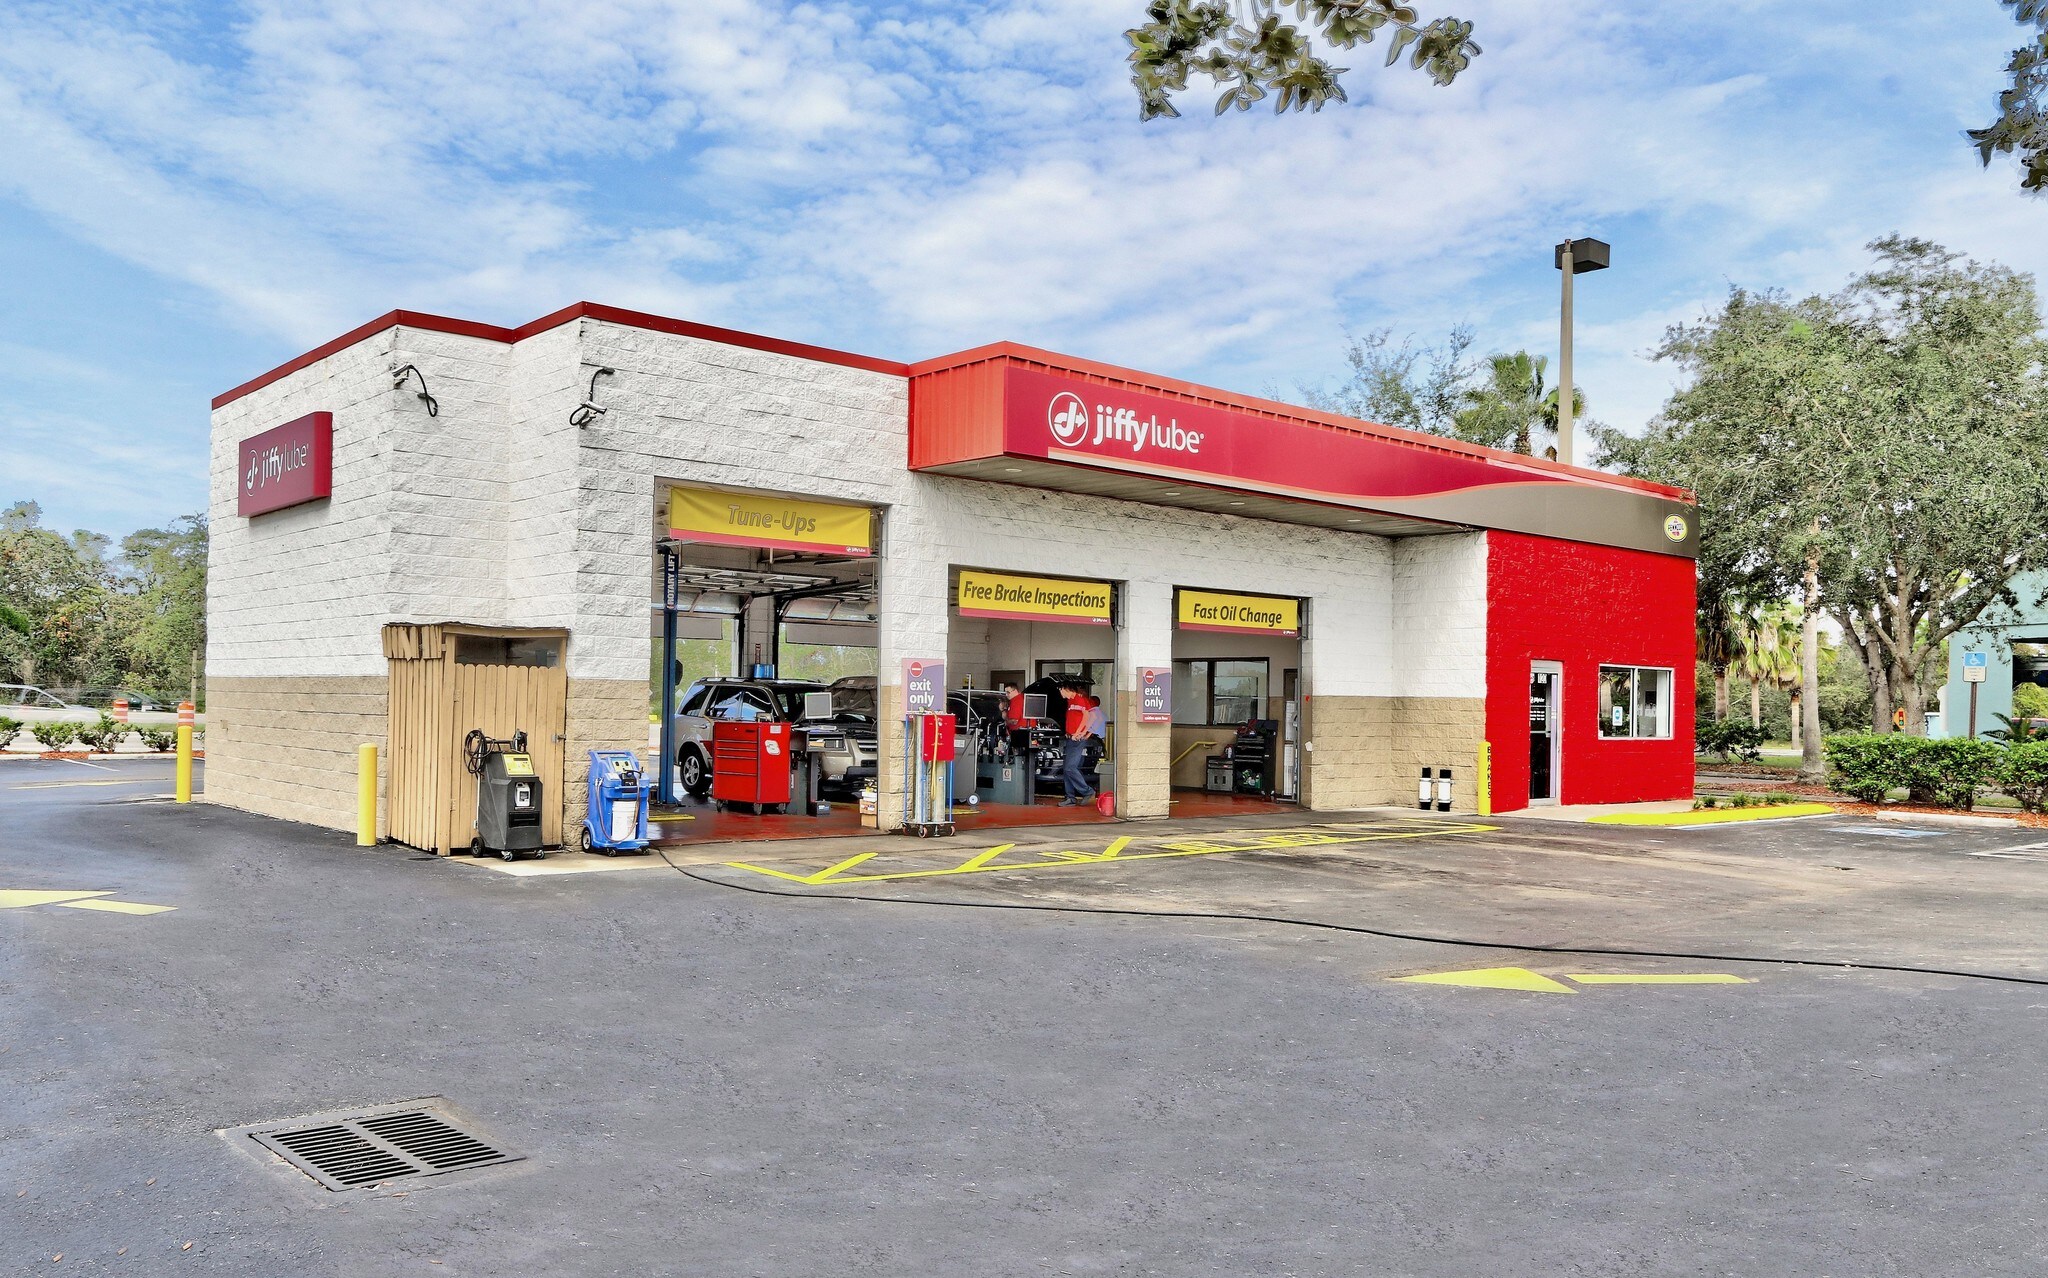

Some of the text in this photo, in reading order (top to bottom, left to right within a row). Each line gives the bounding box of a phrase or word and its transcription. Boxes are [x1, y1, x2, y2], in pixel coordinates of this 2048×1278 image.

[728, 504, 816, 536] Tune-Ups
[667, 555, 676, 605] ROTARY LIFT
[964, 581, 1106, 609] Free Brake Inspections
[1193, 603, 1283, 628] Fast Oil Change
[909, 679, 932, 691] exit
[1144, 685, 1161, 696] exit
[909, 692, 935, 707] only
[1144, 696, 1164, 710] only
